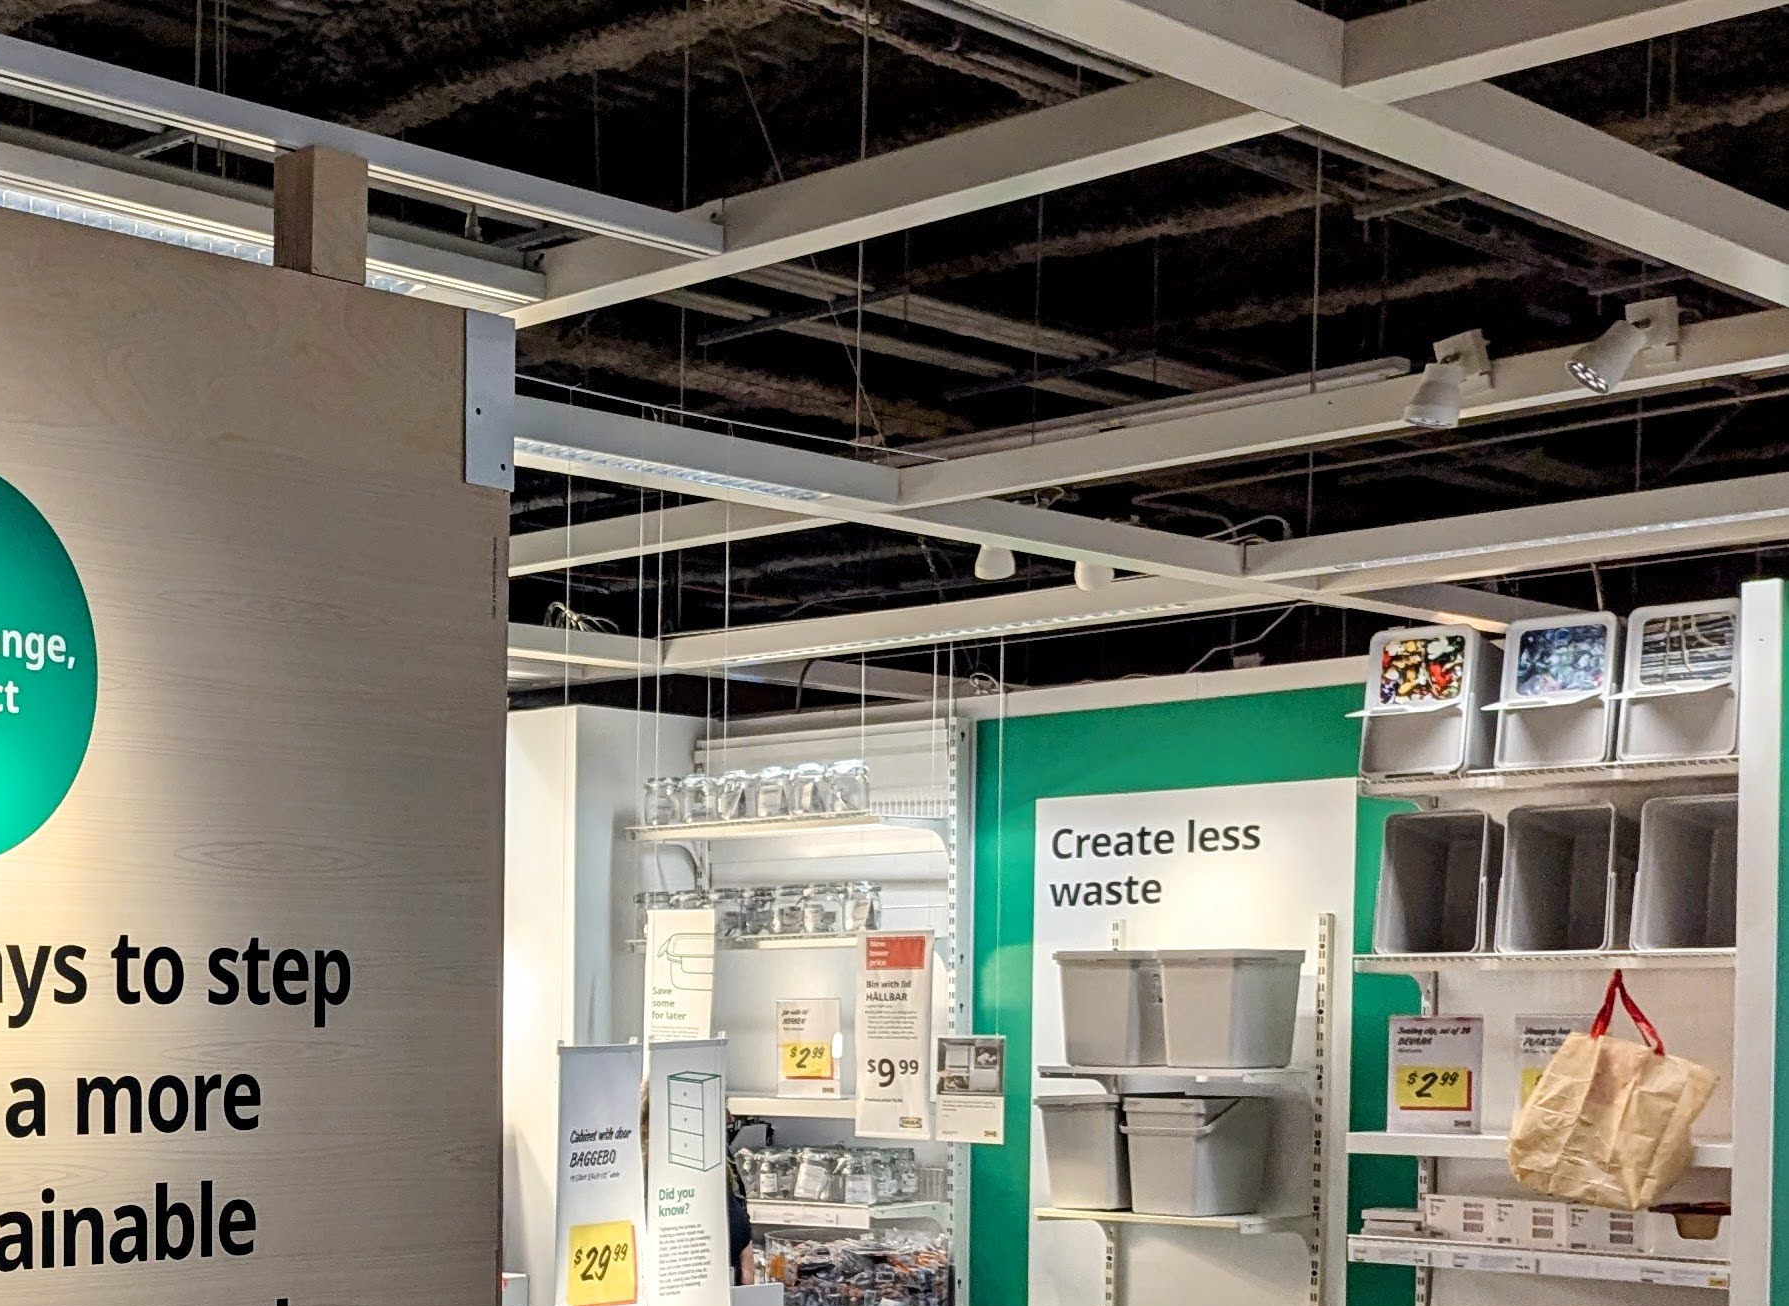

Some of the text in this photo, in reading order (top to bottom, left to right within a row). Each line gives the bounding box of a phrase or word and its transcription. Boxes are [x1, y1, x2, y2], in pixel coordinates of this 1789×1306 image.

[1052, 820, 1260, 859] Create less
[1049, 876, 1162, 907] waste
[111, 935, 185, 1005] to
[208, 937, 351, 1027] step
[901, 980, 911, 988] lid
[653, 987, 672, 995] Save
[866, 992, 907, 1001] HÅLLBAR
[652, 1011, 686, 1020] for later
[5, 1075, 46, 1137] a
[77, 1073, 261, 1135] more
[570, 1149, 616, 1168] BAGGEBO
[659, 1188, 694, 1202] Did you
[659, 1203, 690, 1217] know?
